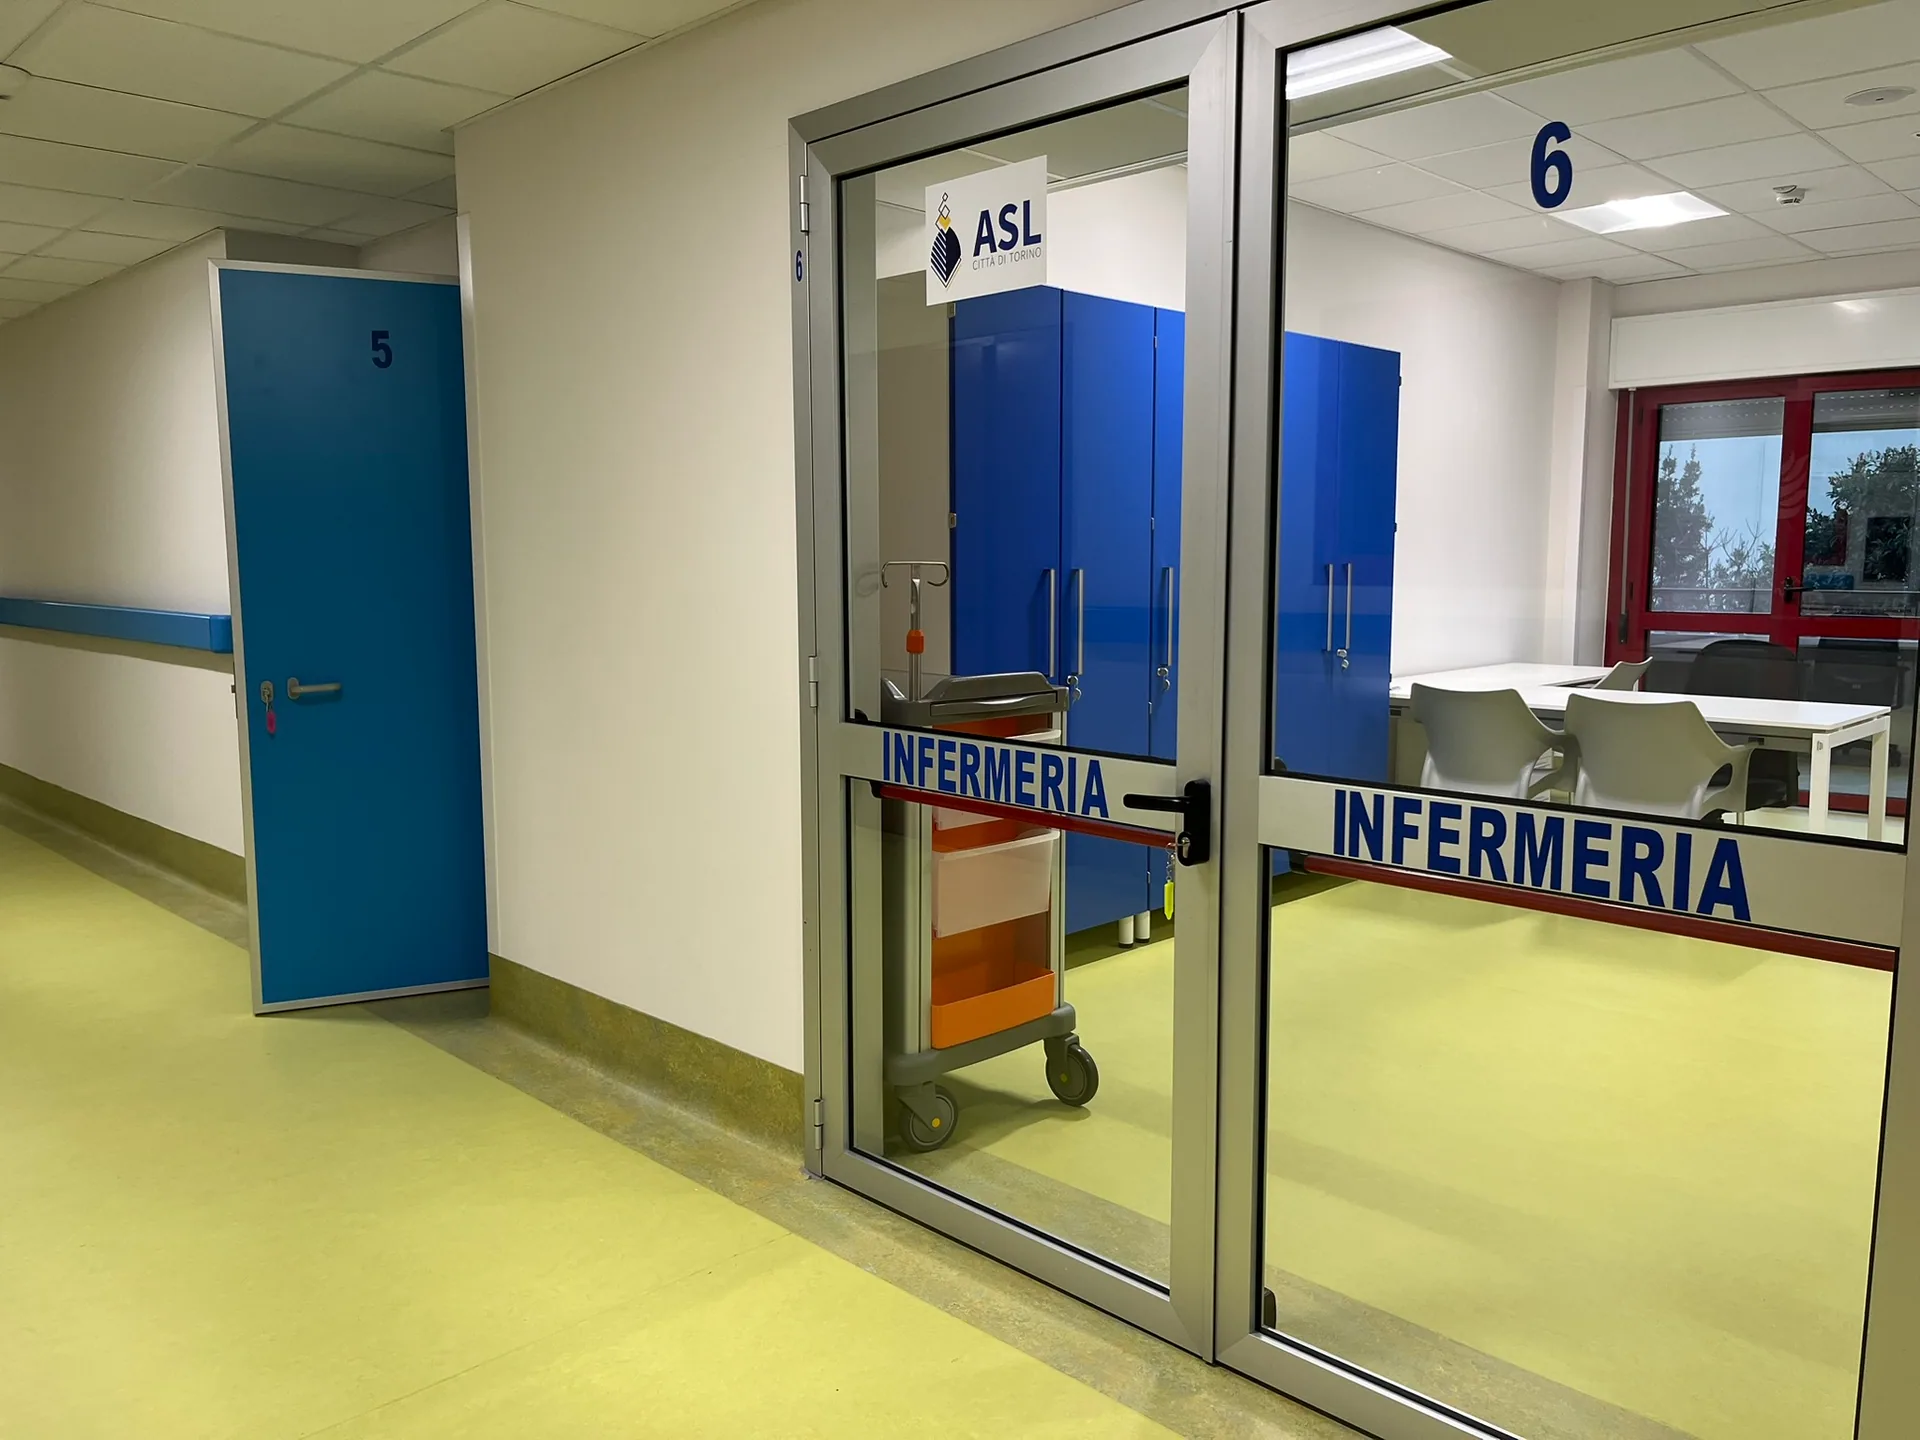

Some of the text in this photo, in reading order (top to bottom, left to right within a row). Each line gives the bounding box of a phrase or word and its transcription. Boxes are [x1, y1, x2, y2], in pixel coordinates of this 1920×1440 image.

[1531, 121, 1573, 209] 6
[973, 199, 1042, 257] ASL
[795, 249, 803, 282] 6
[972, 246, 1042, 271] CITTÀ DI TORINO
[371, 330, 393, 369] 5
[882, 730, 1110, 819] INFERMERIA
[1332, 788, 1752, 922] INFERMERIA
